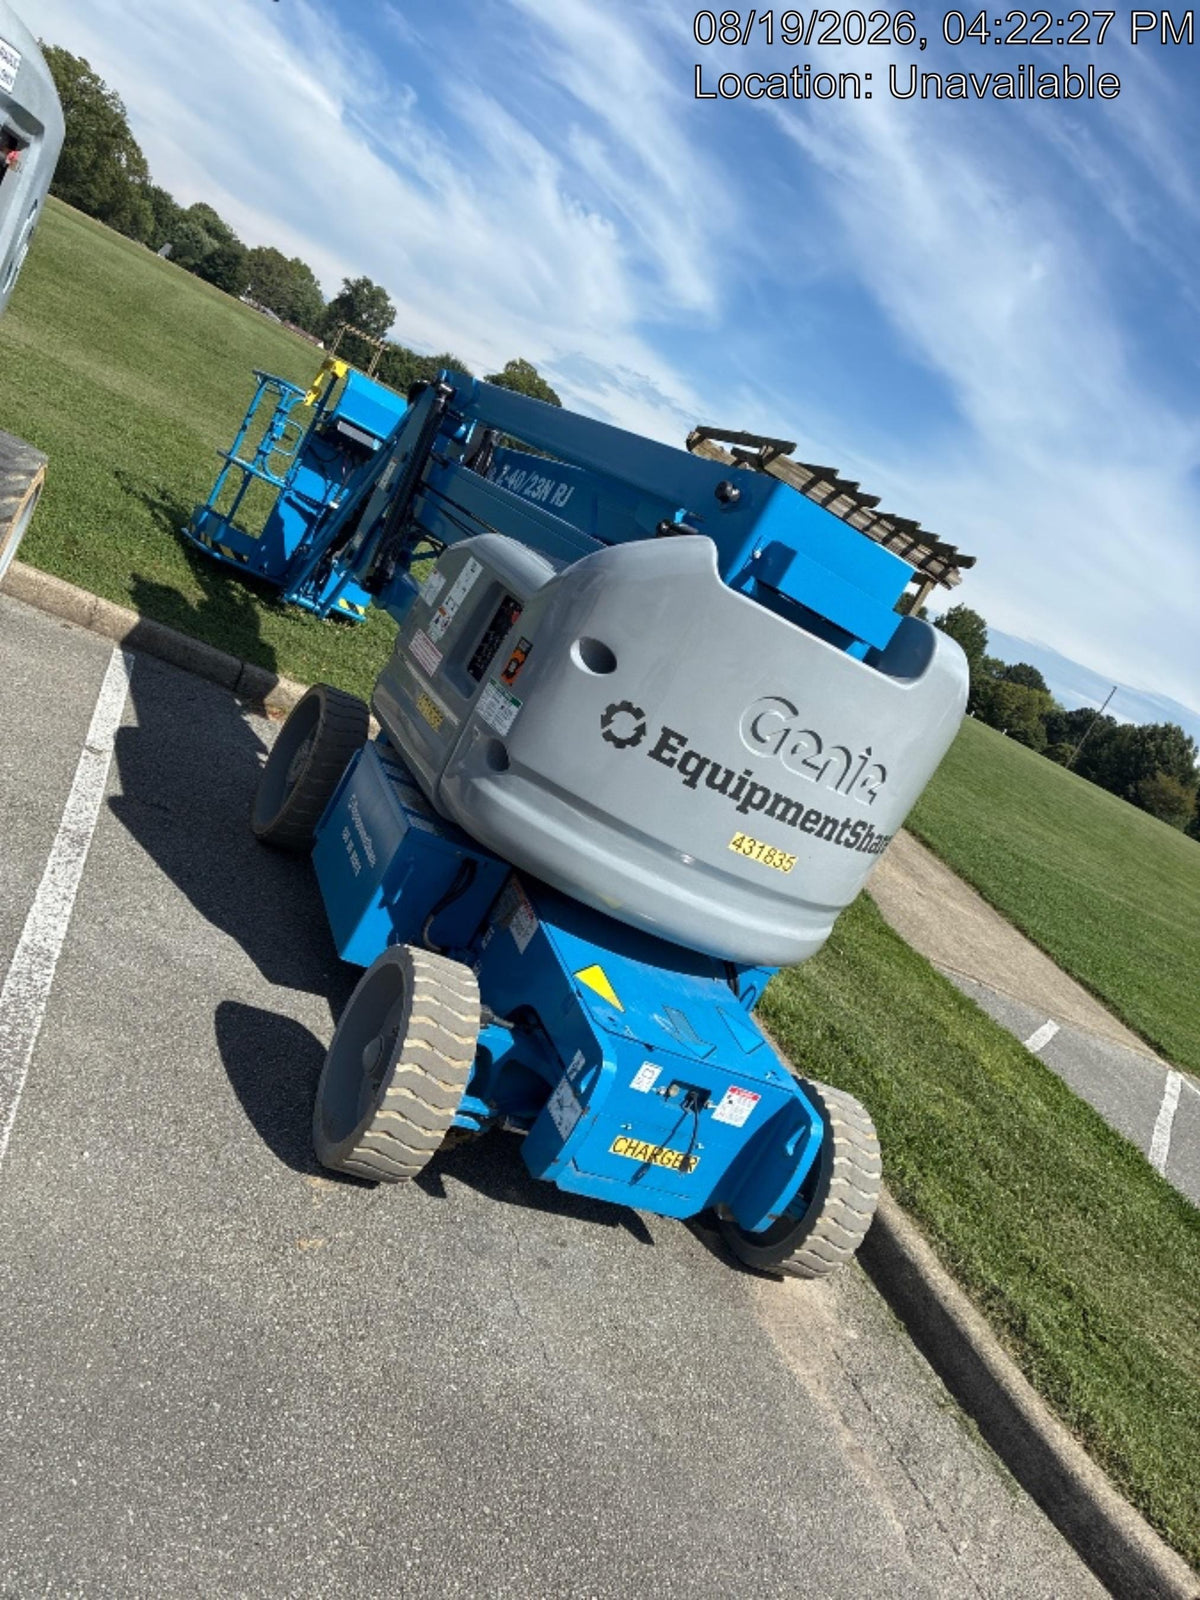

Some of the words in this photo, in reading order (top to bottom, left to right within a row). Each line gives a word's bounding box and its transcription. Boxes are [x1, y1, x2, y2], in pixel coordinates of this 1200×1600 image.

[738, 695, 887, 806] Genie
[647, 725, 894, 855] EquipmentShar
[731, 834, 797, 873] 431835
[612, 1137, 698, 1173] CHARGER
